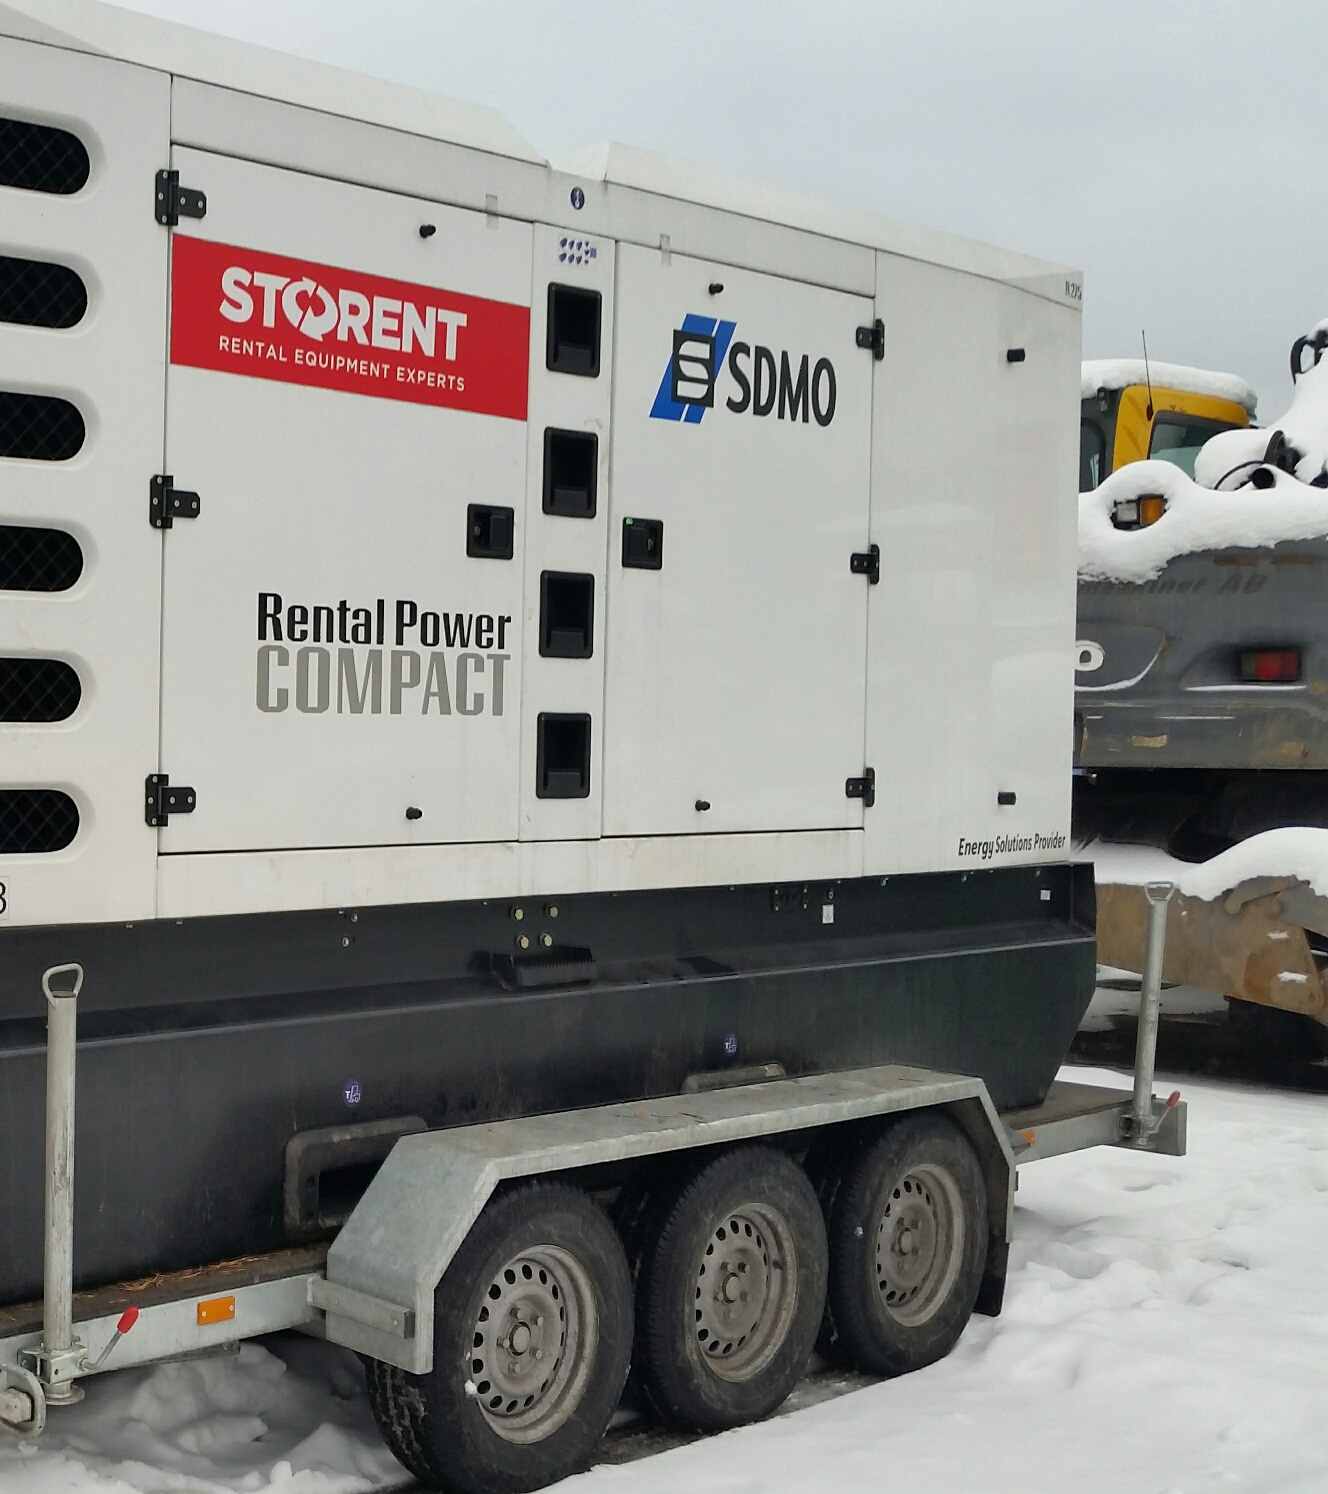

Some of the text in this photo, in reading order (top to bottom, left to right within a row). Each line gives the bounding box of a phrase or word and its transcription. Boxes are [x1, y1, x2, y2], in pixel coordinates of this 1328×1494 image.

[219, 266, 468, 361] STORENT
[219, 335, 465, 391] RENTAL EQUIPMENT EXPERTS
[726, 341, 837, 427] SDMO
[257, 592, 512, 650] Rental Power
[256, 645, 511, 716] COMPACT
[958, 831, 1066, 860] Energy Solutions Provider
